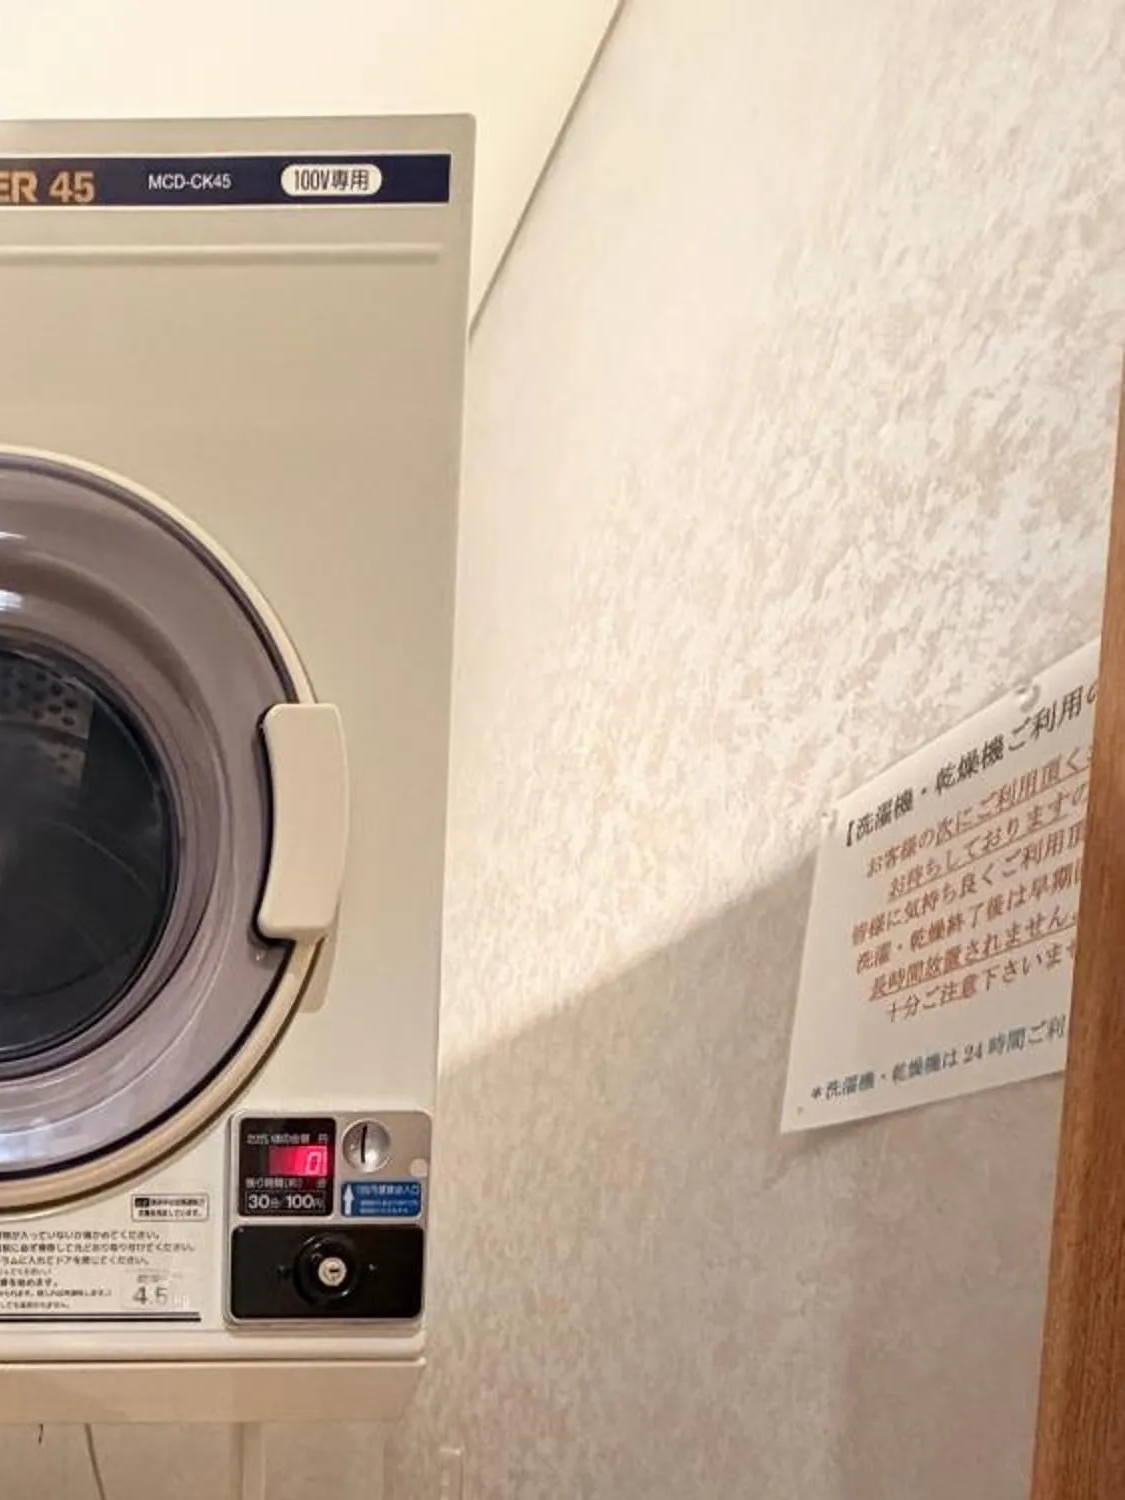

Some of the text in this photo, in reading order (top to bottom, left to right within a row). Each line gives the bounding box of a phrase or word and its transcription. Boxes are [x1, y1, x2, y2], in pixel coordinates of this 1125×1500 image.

[48, 170, 95, 205] 45
[147, 173, 233, 190] MCD-CK45
[293, 168, 370, 192] 100V専用
[867, 746, 1090, 878] お客様の次にご利用頂く
[871, 905, 1076, 1000] 長時間放置されません
